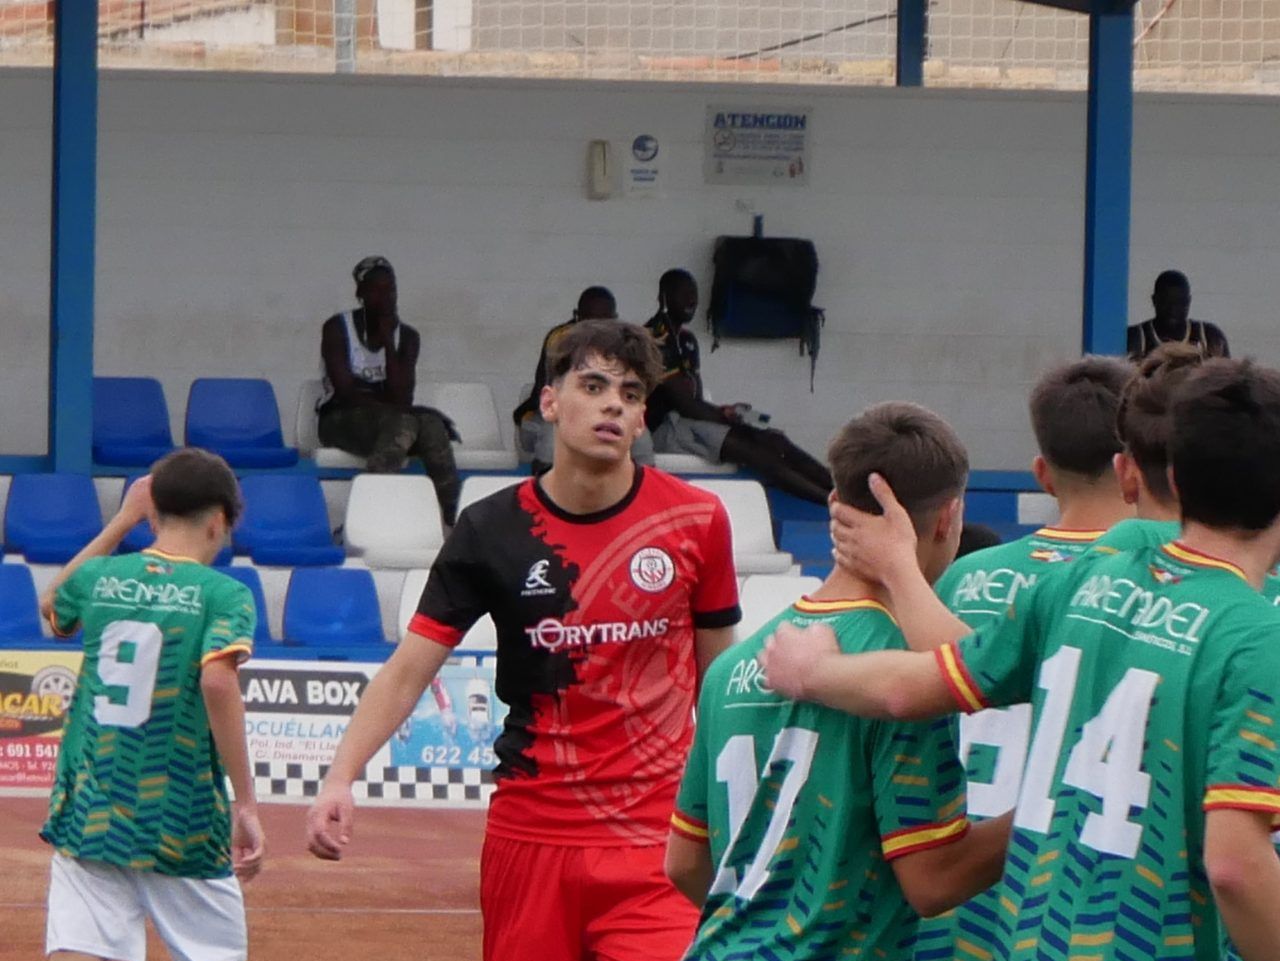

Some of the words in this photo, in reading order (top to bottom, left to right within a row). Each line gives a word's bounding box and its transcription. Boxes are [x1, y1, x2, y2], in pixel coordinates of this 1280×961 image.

[524, 617, 670, 652] TORYTRANS
[94, 620, 163, 728] 9
[0, 691, 62, 717] CAR
[306, 680, 360, 706] BOX
[422, 745, 461, 765] 622
[467, 746, 494, 765] 45
[1013, 645, 1160, 860] 14
[708, 726, 820, 901] 17
